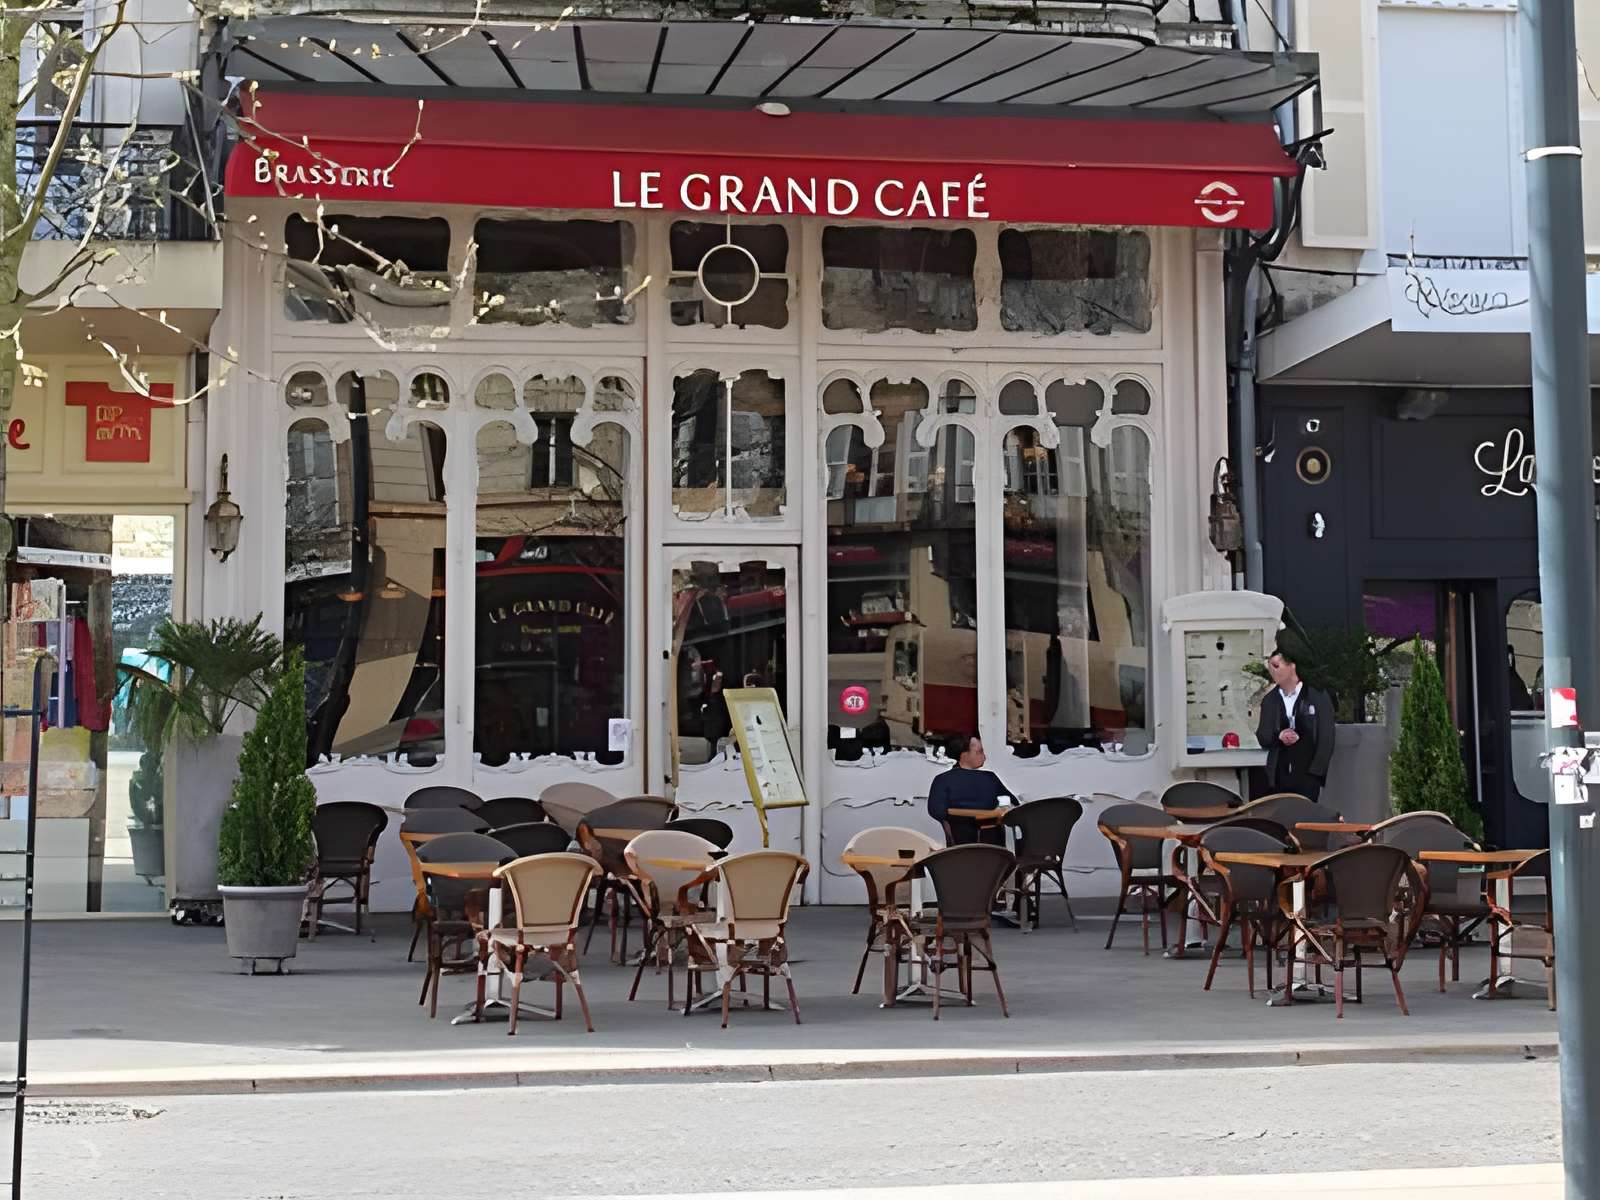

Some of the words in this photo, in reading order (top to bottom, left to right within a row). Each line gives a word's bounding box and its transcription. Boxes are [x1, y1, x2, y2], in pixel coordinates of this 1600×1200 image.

[612, 170, 664, 209] LE
[679, 173, 859, 216] GRAND
[874, 172, 990, 219] CAFÉ
